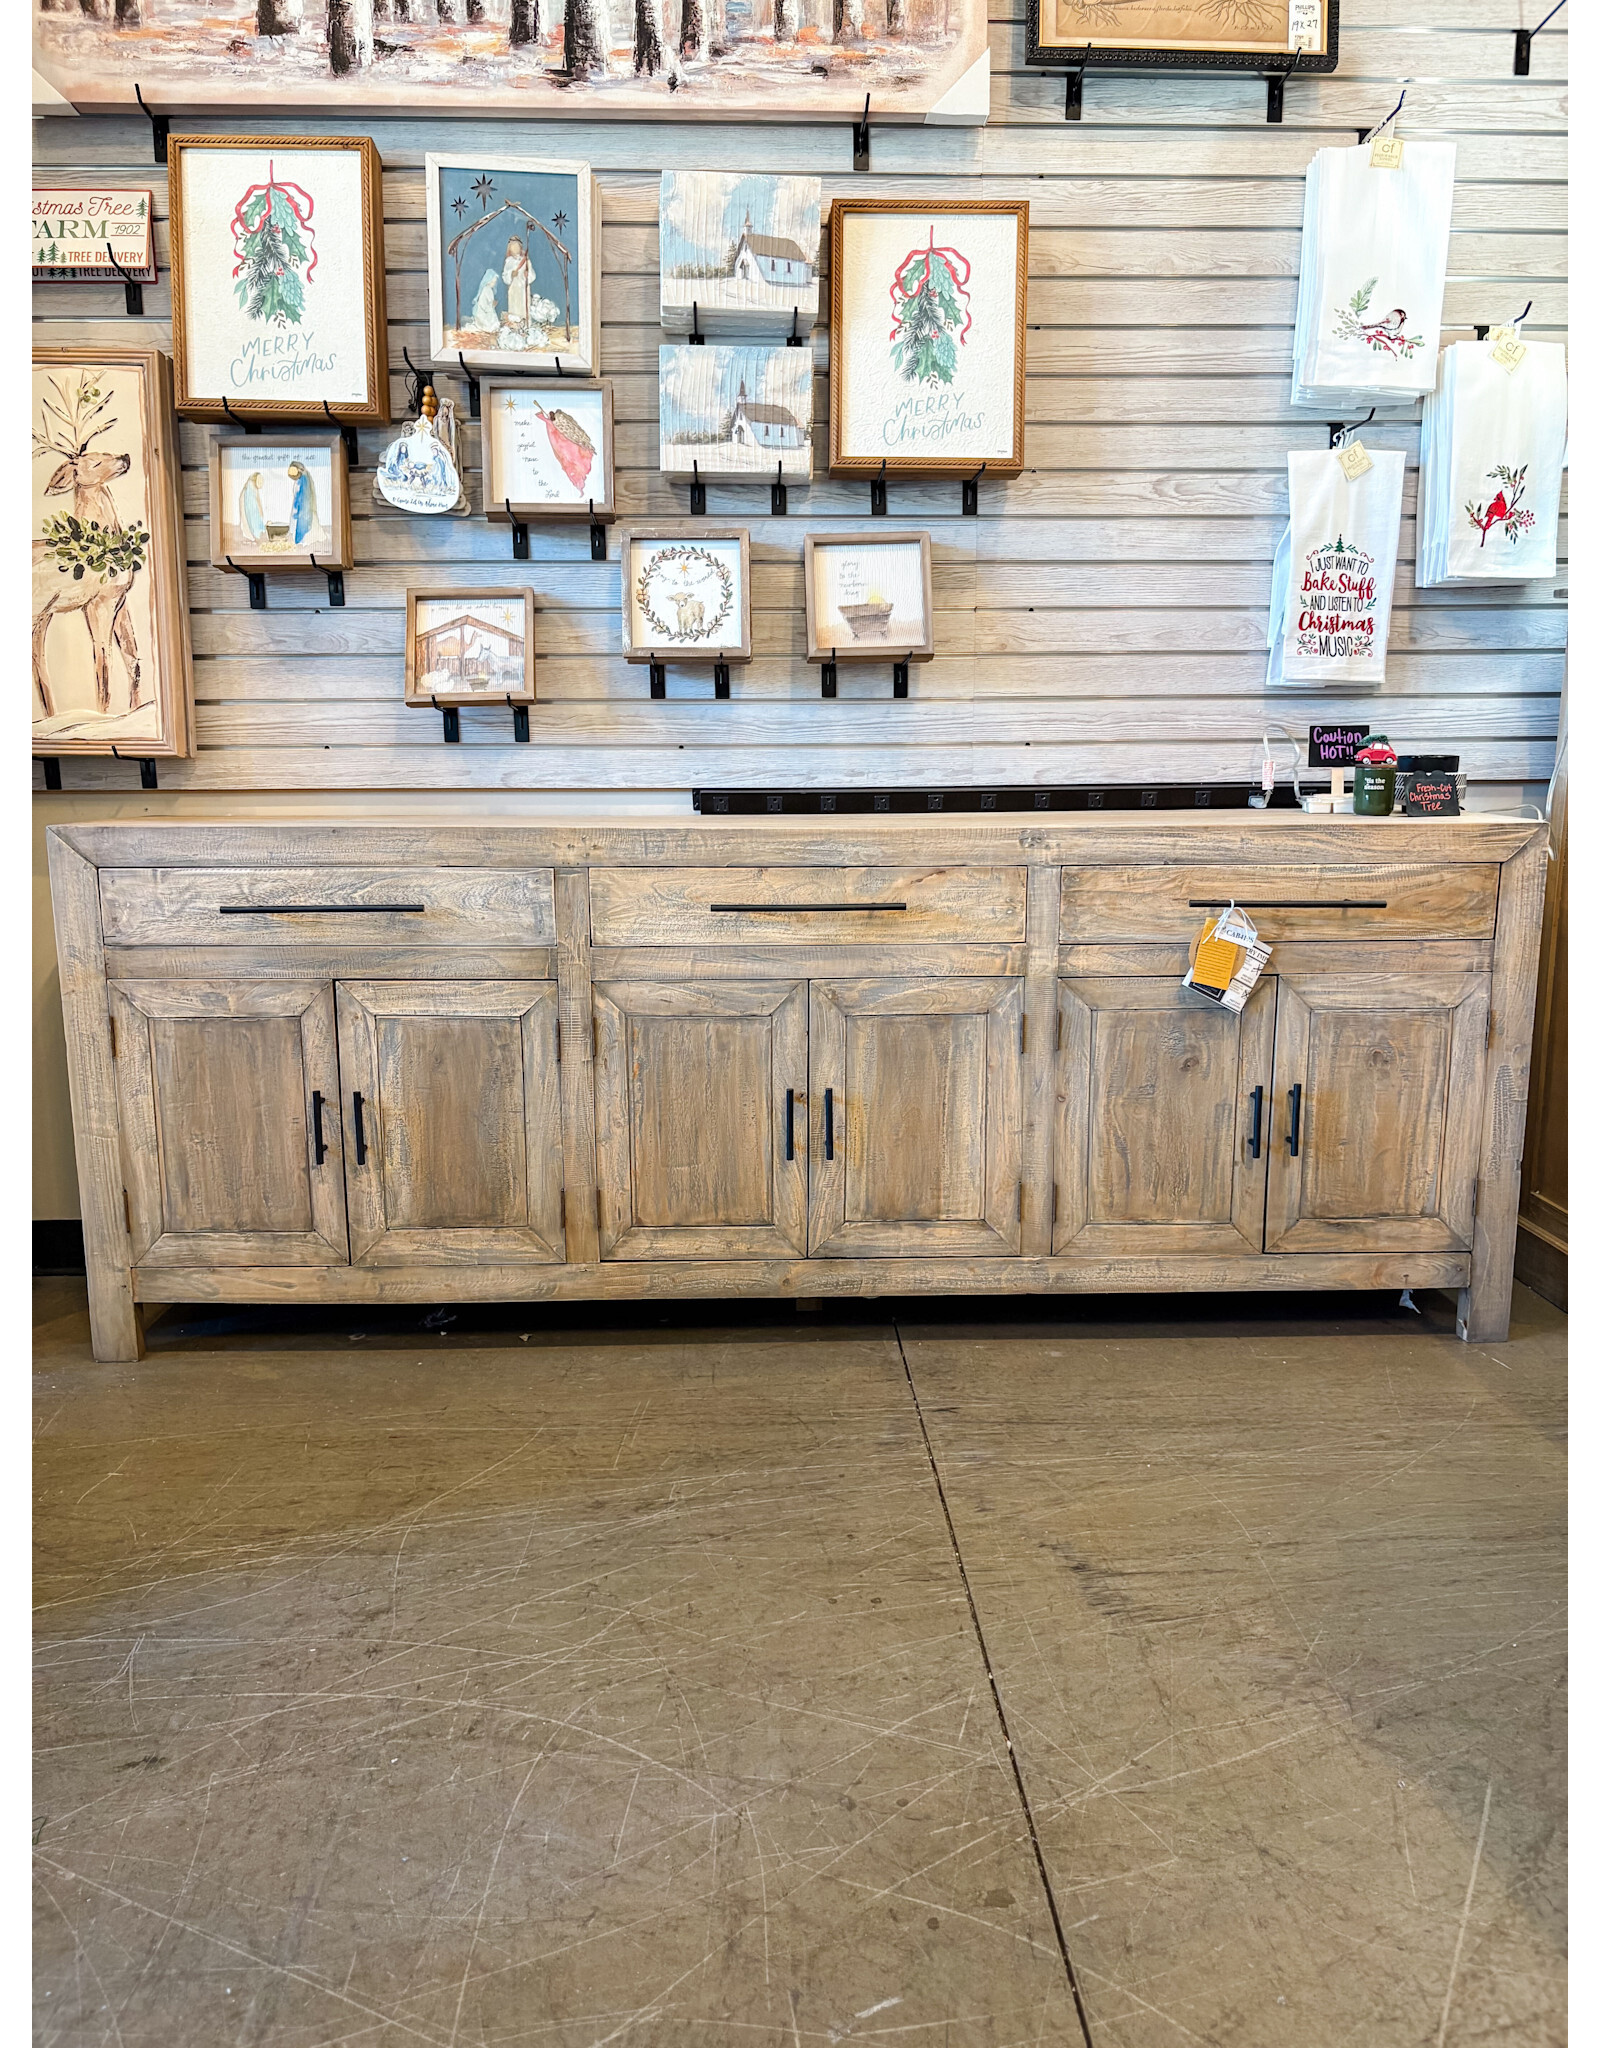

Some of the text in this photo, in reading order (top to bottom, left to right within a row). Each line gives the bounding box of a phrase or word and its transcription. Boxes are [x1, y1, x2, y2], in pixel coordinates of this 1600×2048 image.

[88, 196, 134, 216] Tree
[114, 224, 141, 235] 1902
[68, 251, 144, 263] TREE DEIVERY
[79, 267, 102, 277] TREE
[107, 265, 152, 277] DELVERY
[242, 331, 315, 358] MERRY
[230, 351, 337, 388] Christmas
[895, 392, 965, 418] MERRY
[883, 410, 985, 446] Christmas
[545, 489, 560, 498] Lord
[1315, 556, 1334, 572] JUST
[1335, 555, 1356, 572] WANT
[1358, 561, 1369, 575] TO
[1301, 571, 1377, 600] Bake Stuff
[1309, 595, 1363, 612] AND LISTEN TO
[1298, 611, 1376, 635] Christmas
[1319, 635, 1353, 657] MUSIC
[1313, 727, 1362, 744] Caution
[1320, 744, 1354, 760] HOT!!
[1409, 791, 1451, 802] Christmas
[1416, 783, 1453, 793] Fresh-Cut
[1420, 801, 1443, 811] Tree
